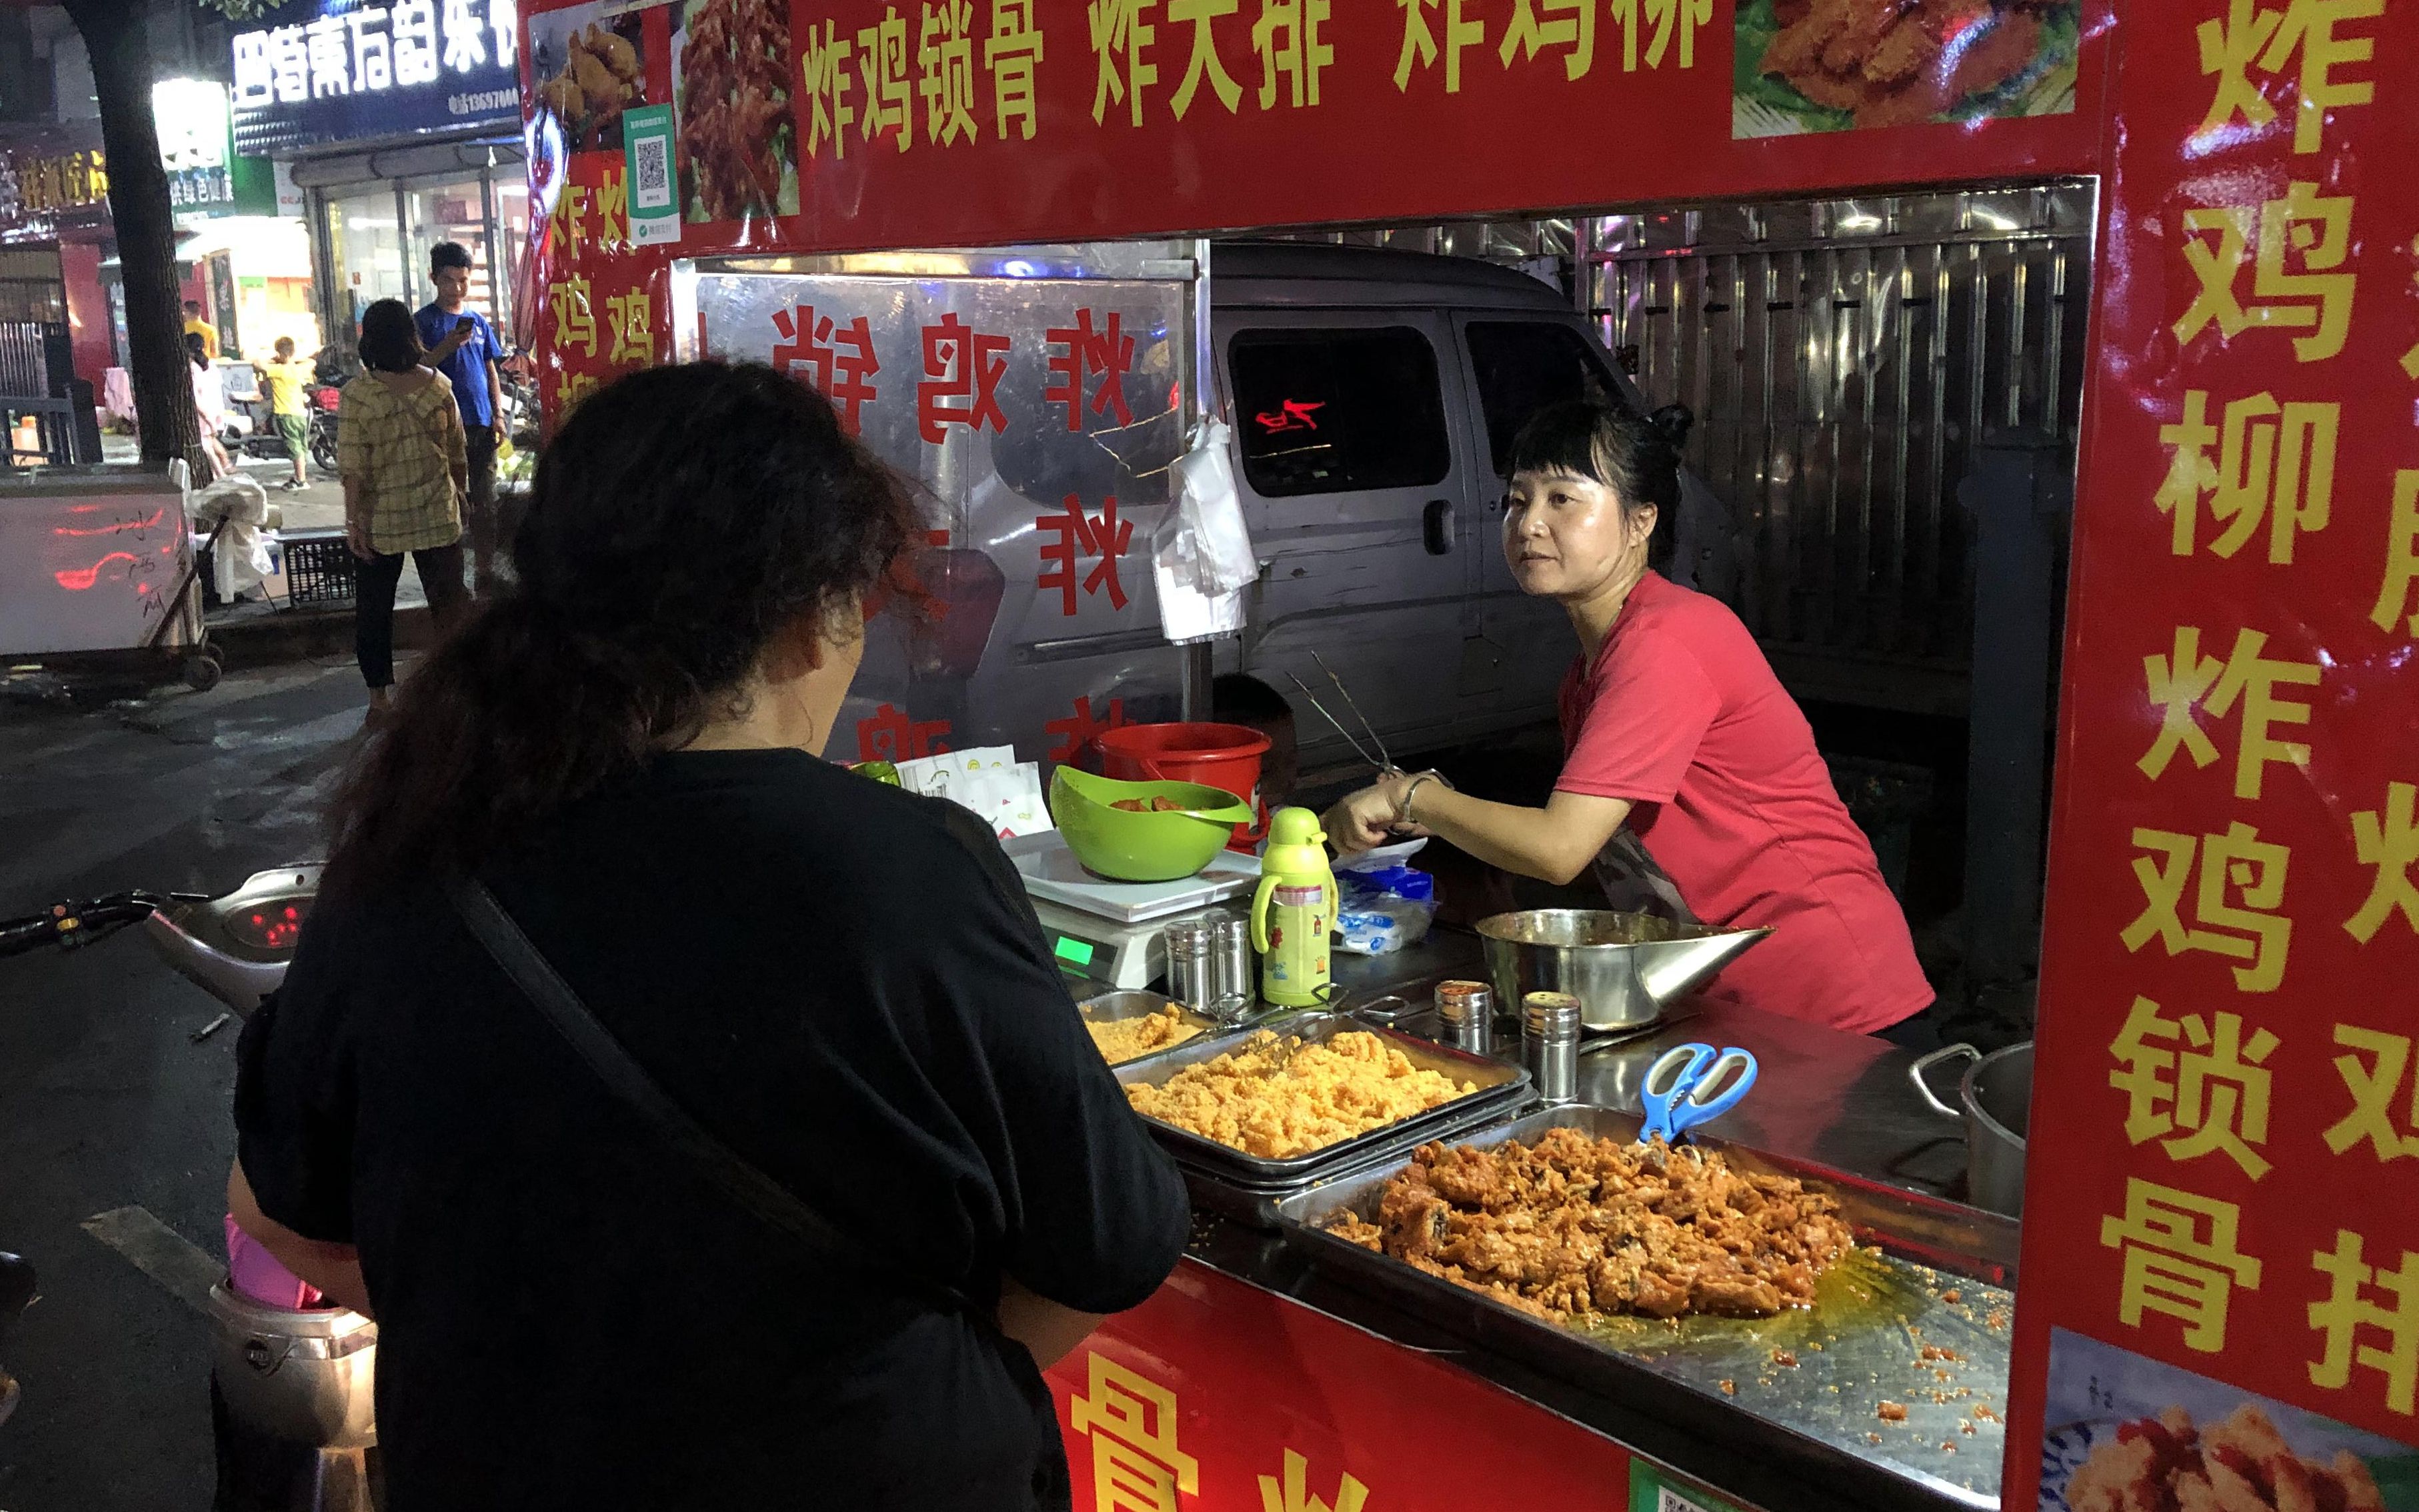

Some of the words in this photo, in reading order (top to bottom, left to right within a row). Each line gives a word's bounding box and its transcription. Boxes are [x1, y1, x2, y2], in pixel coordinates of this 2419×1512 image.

[802, 0, 1043, 161] 炸鸡锁骨
[2154, 0, 2387, 565] 炸鸡柳
[2100, 627, 2322, 1355] 炸鸡锁骨
